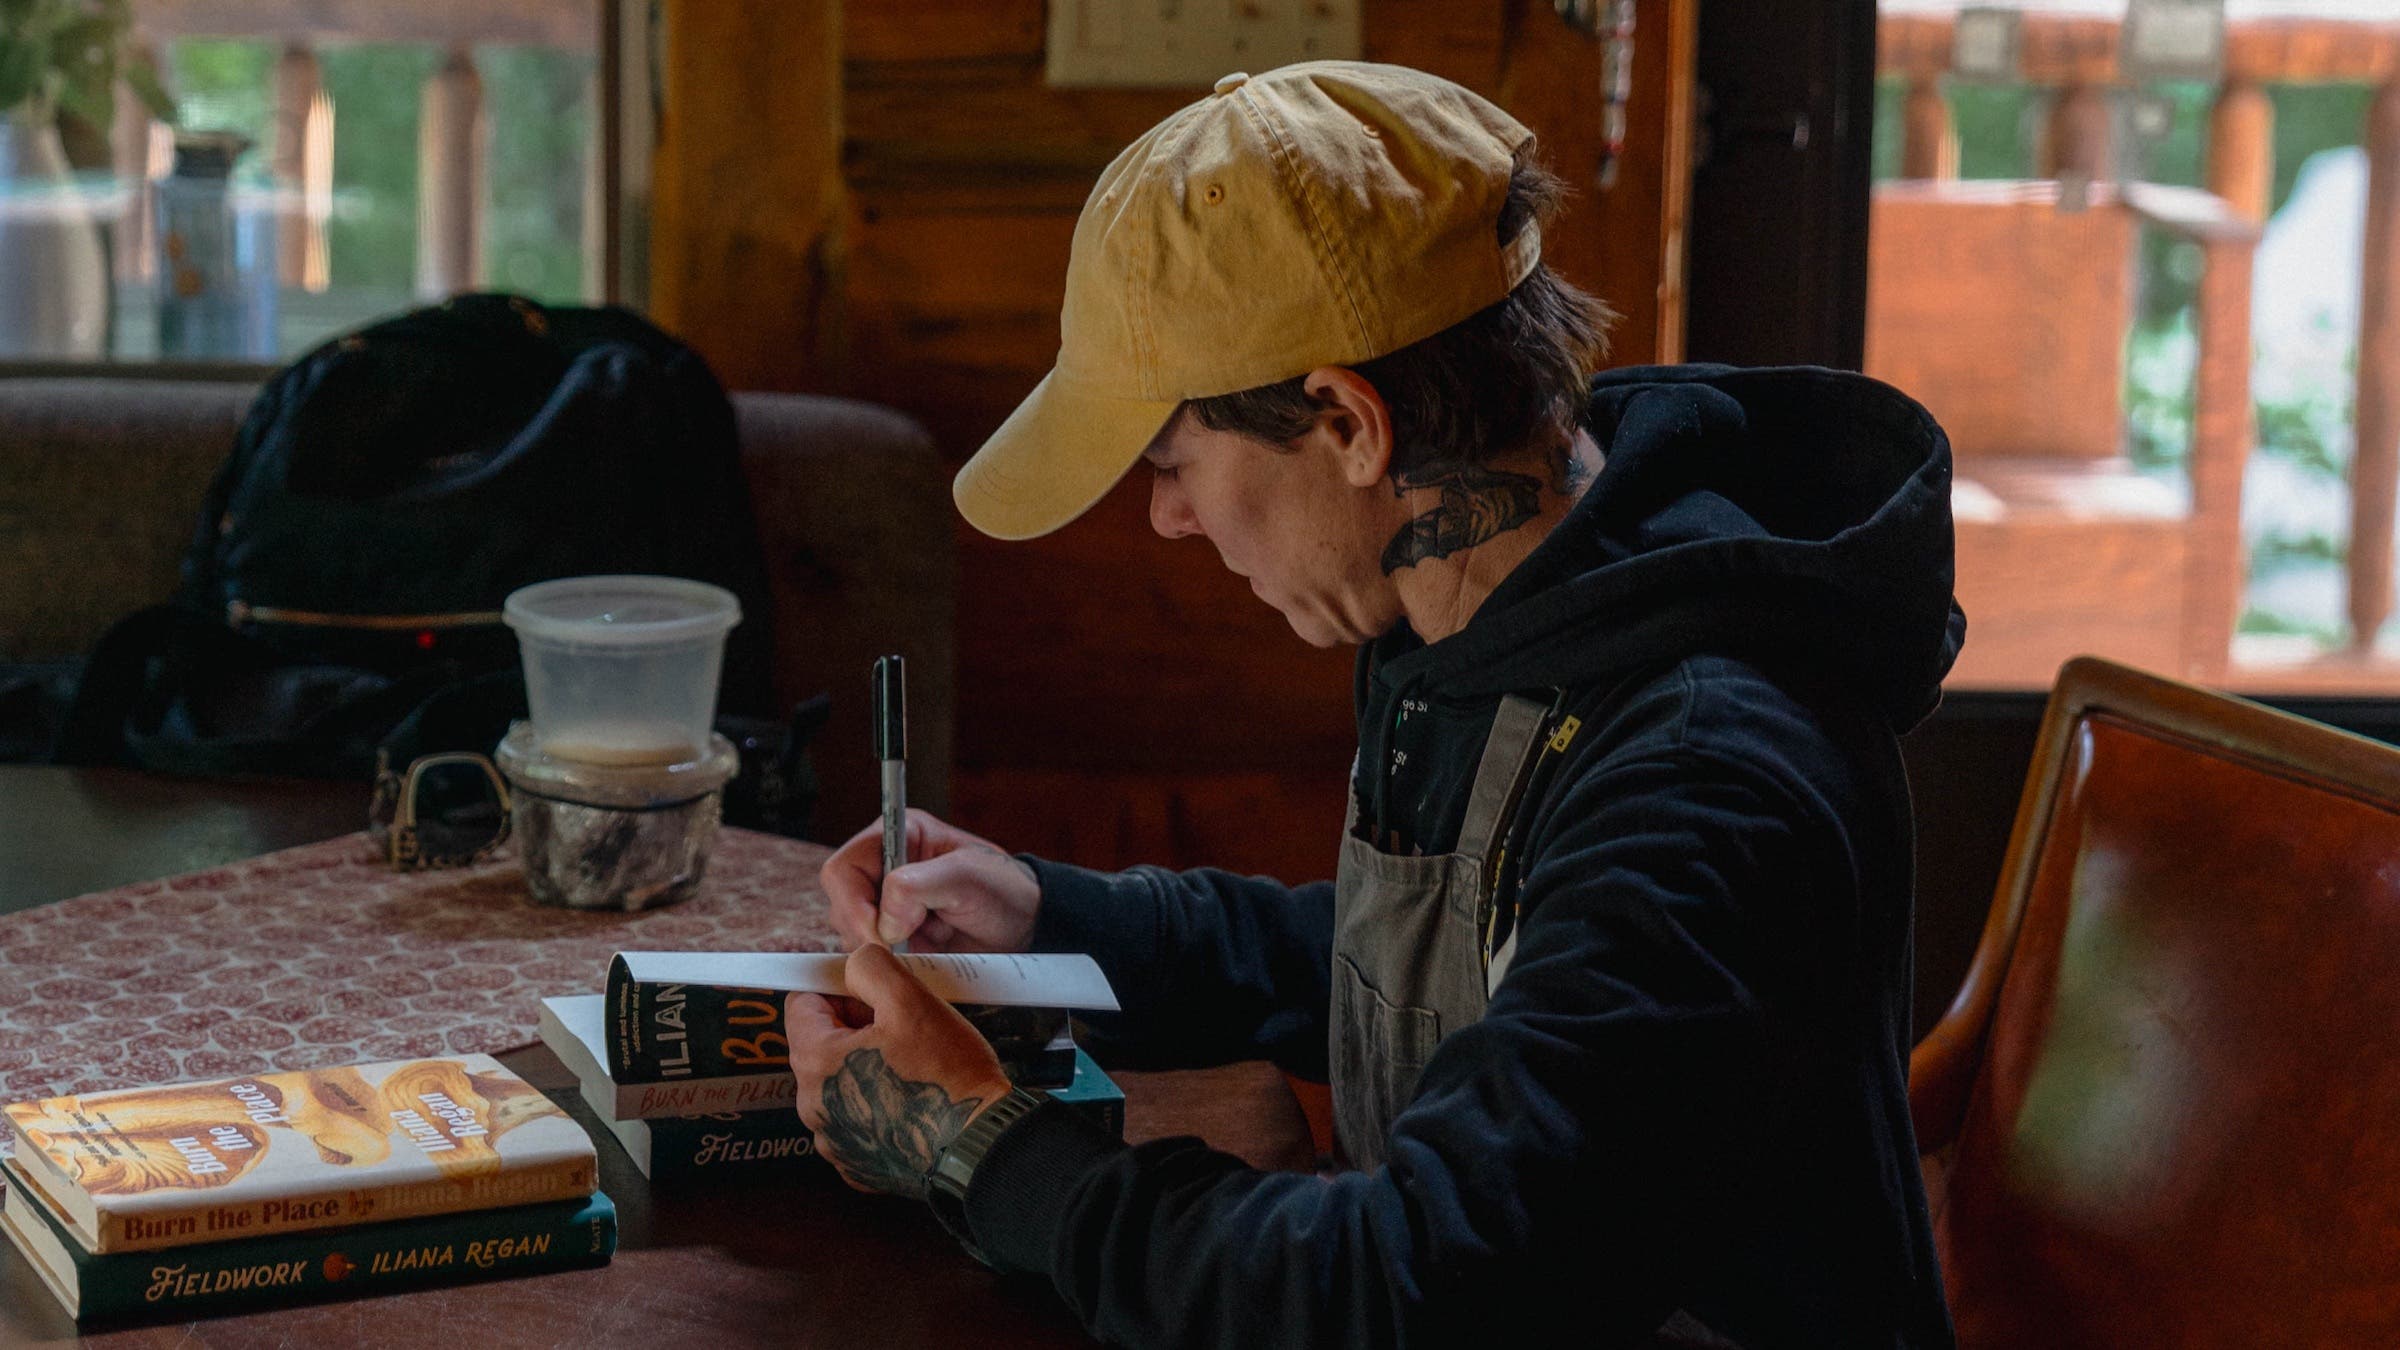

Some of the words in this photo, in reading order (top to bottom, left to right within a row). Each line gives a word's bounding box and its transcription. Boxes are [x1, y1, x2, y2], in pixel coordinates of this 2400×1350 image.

[655, 982, 692, 1077] ILIAN
[720, 985, 791, 1065] BU
[229, 1083, 290, 1125] Place
[417, 1091, 489, 1138] Regan
[640, 1085, 698, 1114] BURN
[208, 1125, 253, 1151] the
[389, 1108, 457, 1153] Iliana
[693, 1131, 815, 1166] FIELDWO
[169, 1135, 228, 1176] Burn
[123, 1215, 197, 1241] Burn
[206, 1206, 252, 1231] the
[262, 1196, 341, 1225] Place
[371, 1245, 454, 1275] ILIANA
[464, 1233, 551, 1269] REGAN
